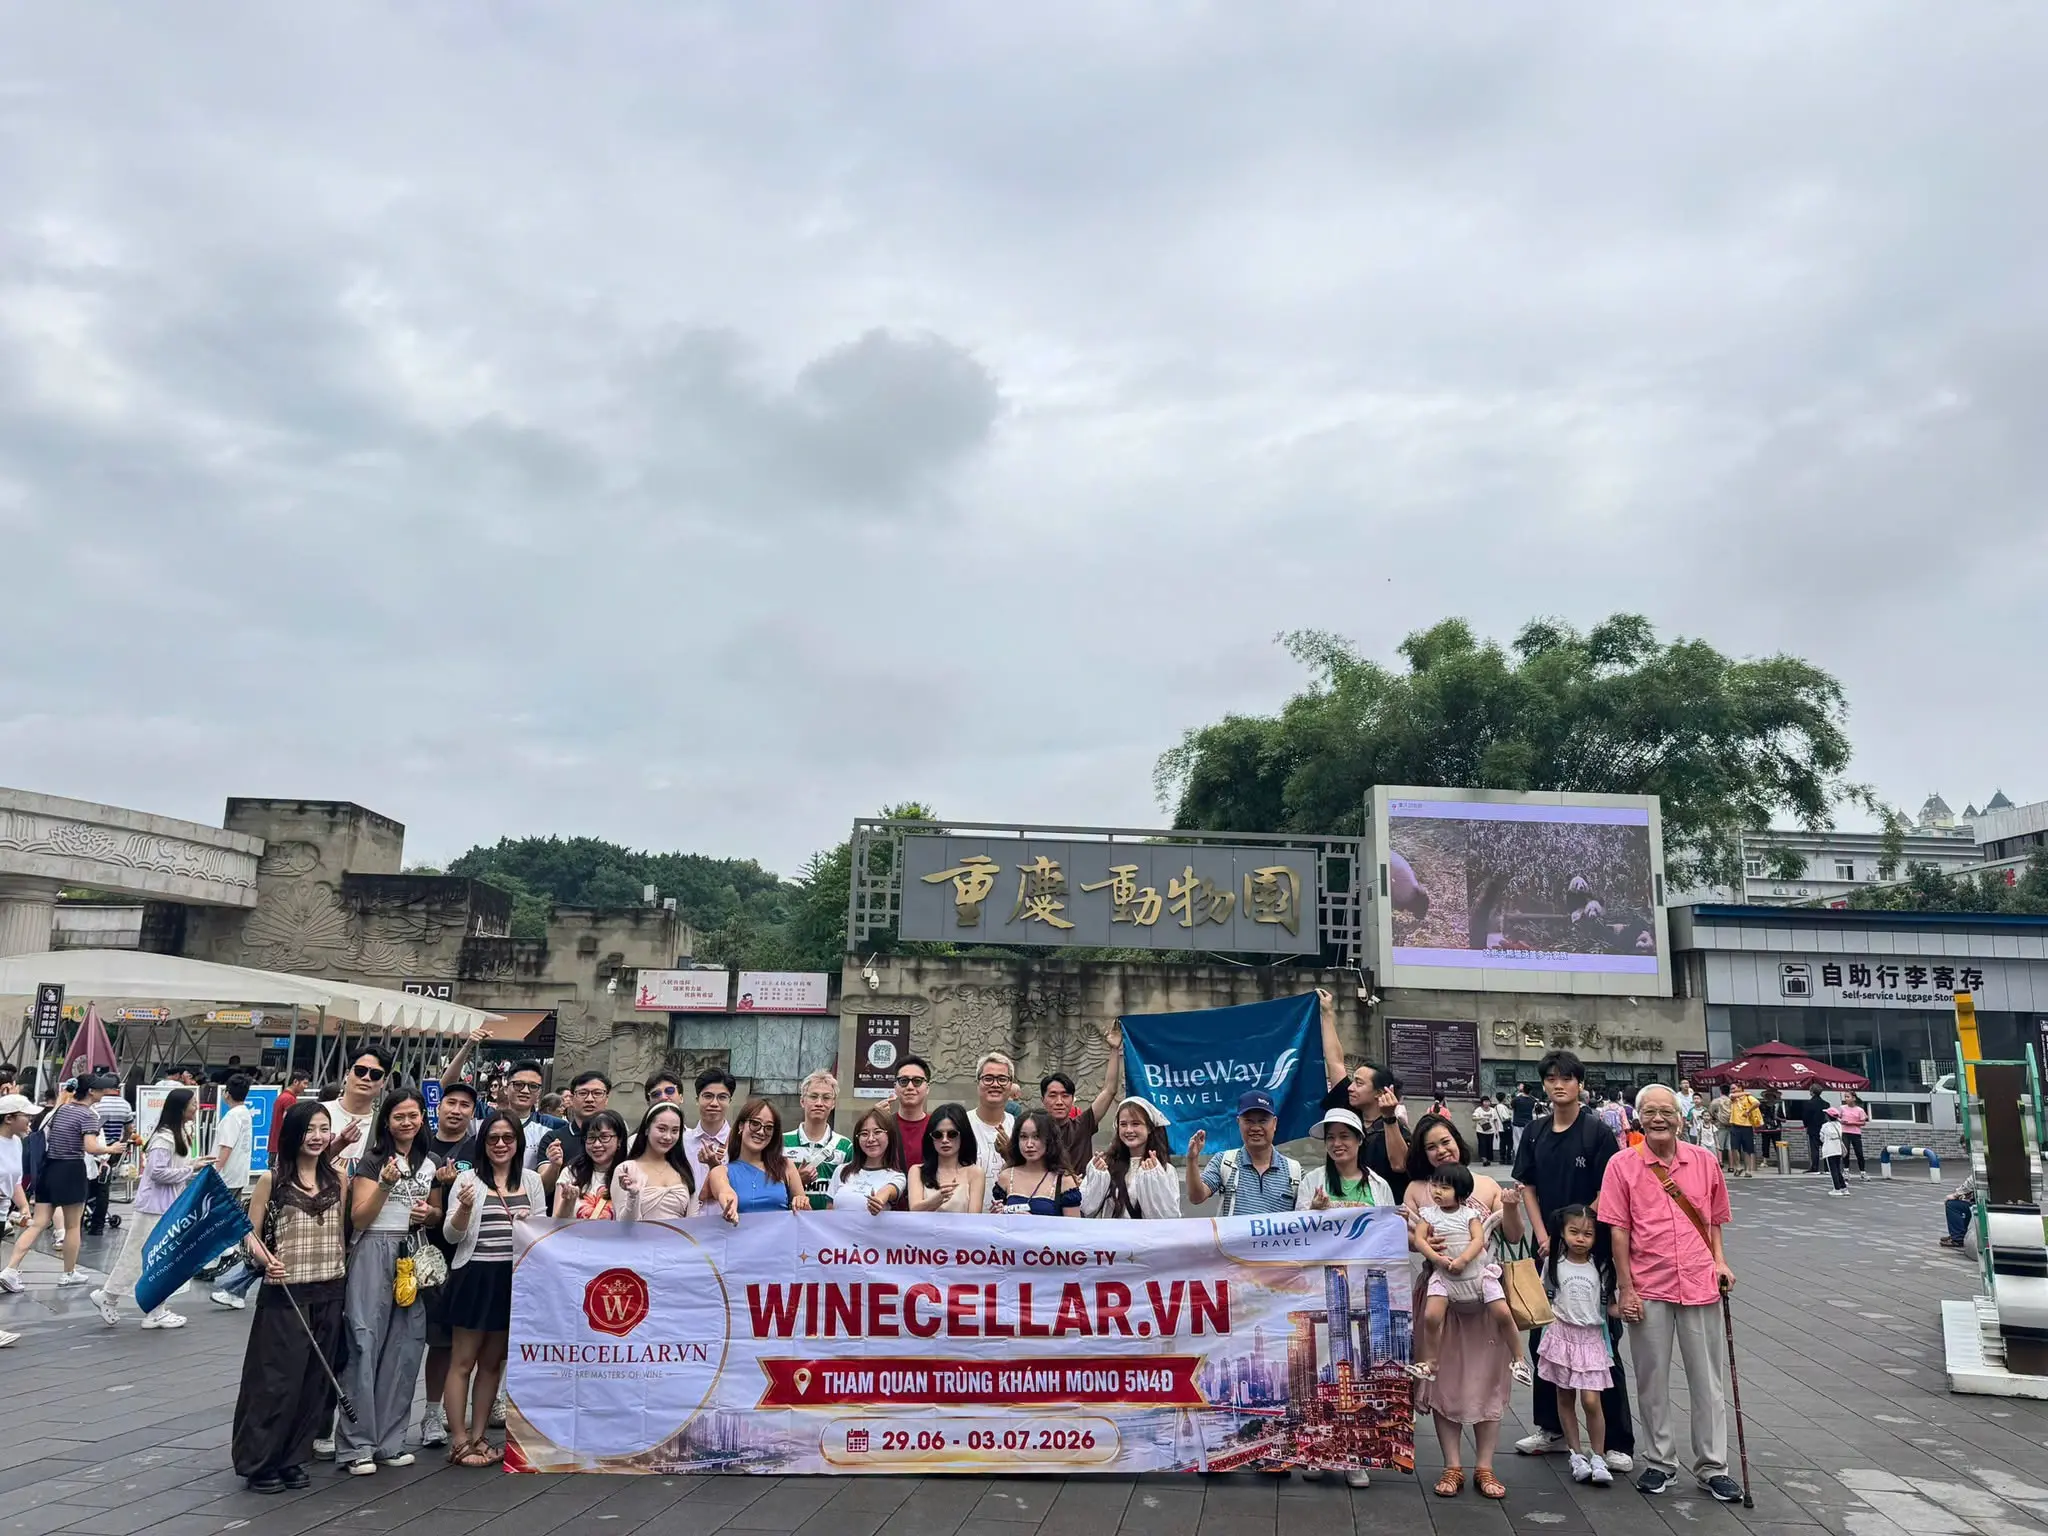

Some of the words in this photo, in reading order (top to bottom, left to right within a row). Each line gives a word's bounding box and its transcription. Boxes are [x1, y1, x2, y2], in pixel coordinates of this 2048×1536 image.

[1822, 963, 1984, 991] 自助行李寄存
[1842, 991, 1894, 1000] Self-service
[1896, 992, 1933, 1003] Luggage
[1934, 993, 1955, 1002] Stor
[1143, 1059, 1266, 1088] BlueWay
[1151, 1092, 1223, 1105] TRAVEL
[1250, 1216, 1346, 1236] BlueWay
[1252, 1237, 1311, 1248] TRAVEL
[817, 1243, 880, 1265] CHÀO
[886, 1243, 949, 1265] MỪNG
[955, 1244, 1015, 1266] ĐOÀN
[1022, 1245, 1088, 1266] CÔNG
[1093, 1250, 1117, 1266] TY
[601, 1294, 634, 1321] W
[745, 1279, 1232, 1339] WINECELLAR.VN
[519, 1343, 708, 1363] WINECELLAR.VN
[560, 1368, 574, 1378] WE
[575, 1370, 589, 1379] ARE
[591, 1370, 626, 1380] MASTERS
[627, 1371, 641, 1379] OF
[642, 1369, 663, 1379] WINE
[822, 1371, 874, 1394] THAM
[879, 1371, 928, 1396] QUAN
[932, 1366, 993, 1394] TRÙNG
[998, 1366, 1061, 1393] KHÁNH
[1065, 1370, 1120, 1393] MONO
[1125, 1369, 1174, 1392] 5N4Đ
[882, 1430, 946, 1450] 29.06
[967, 1430, 1096, 1451] 03.07.2026
